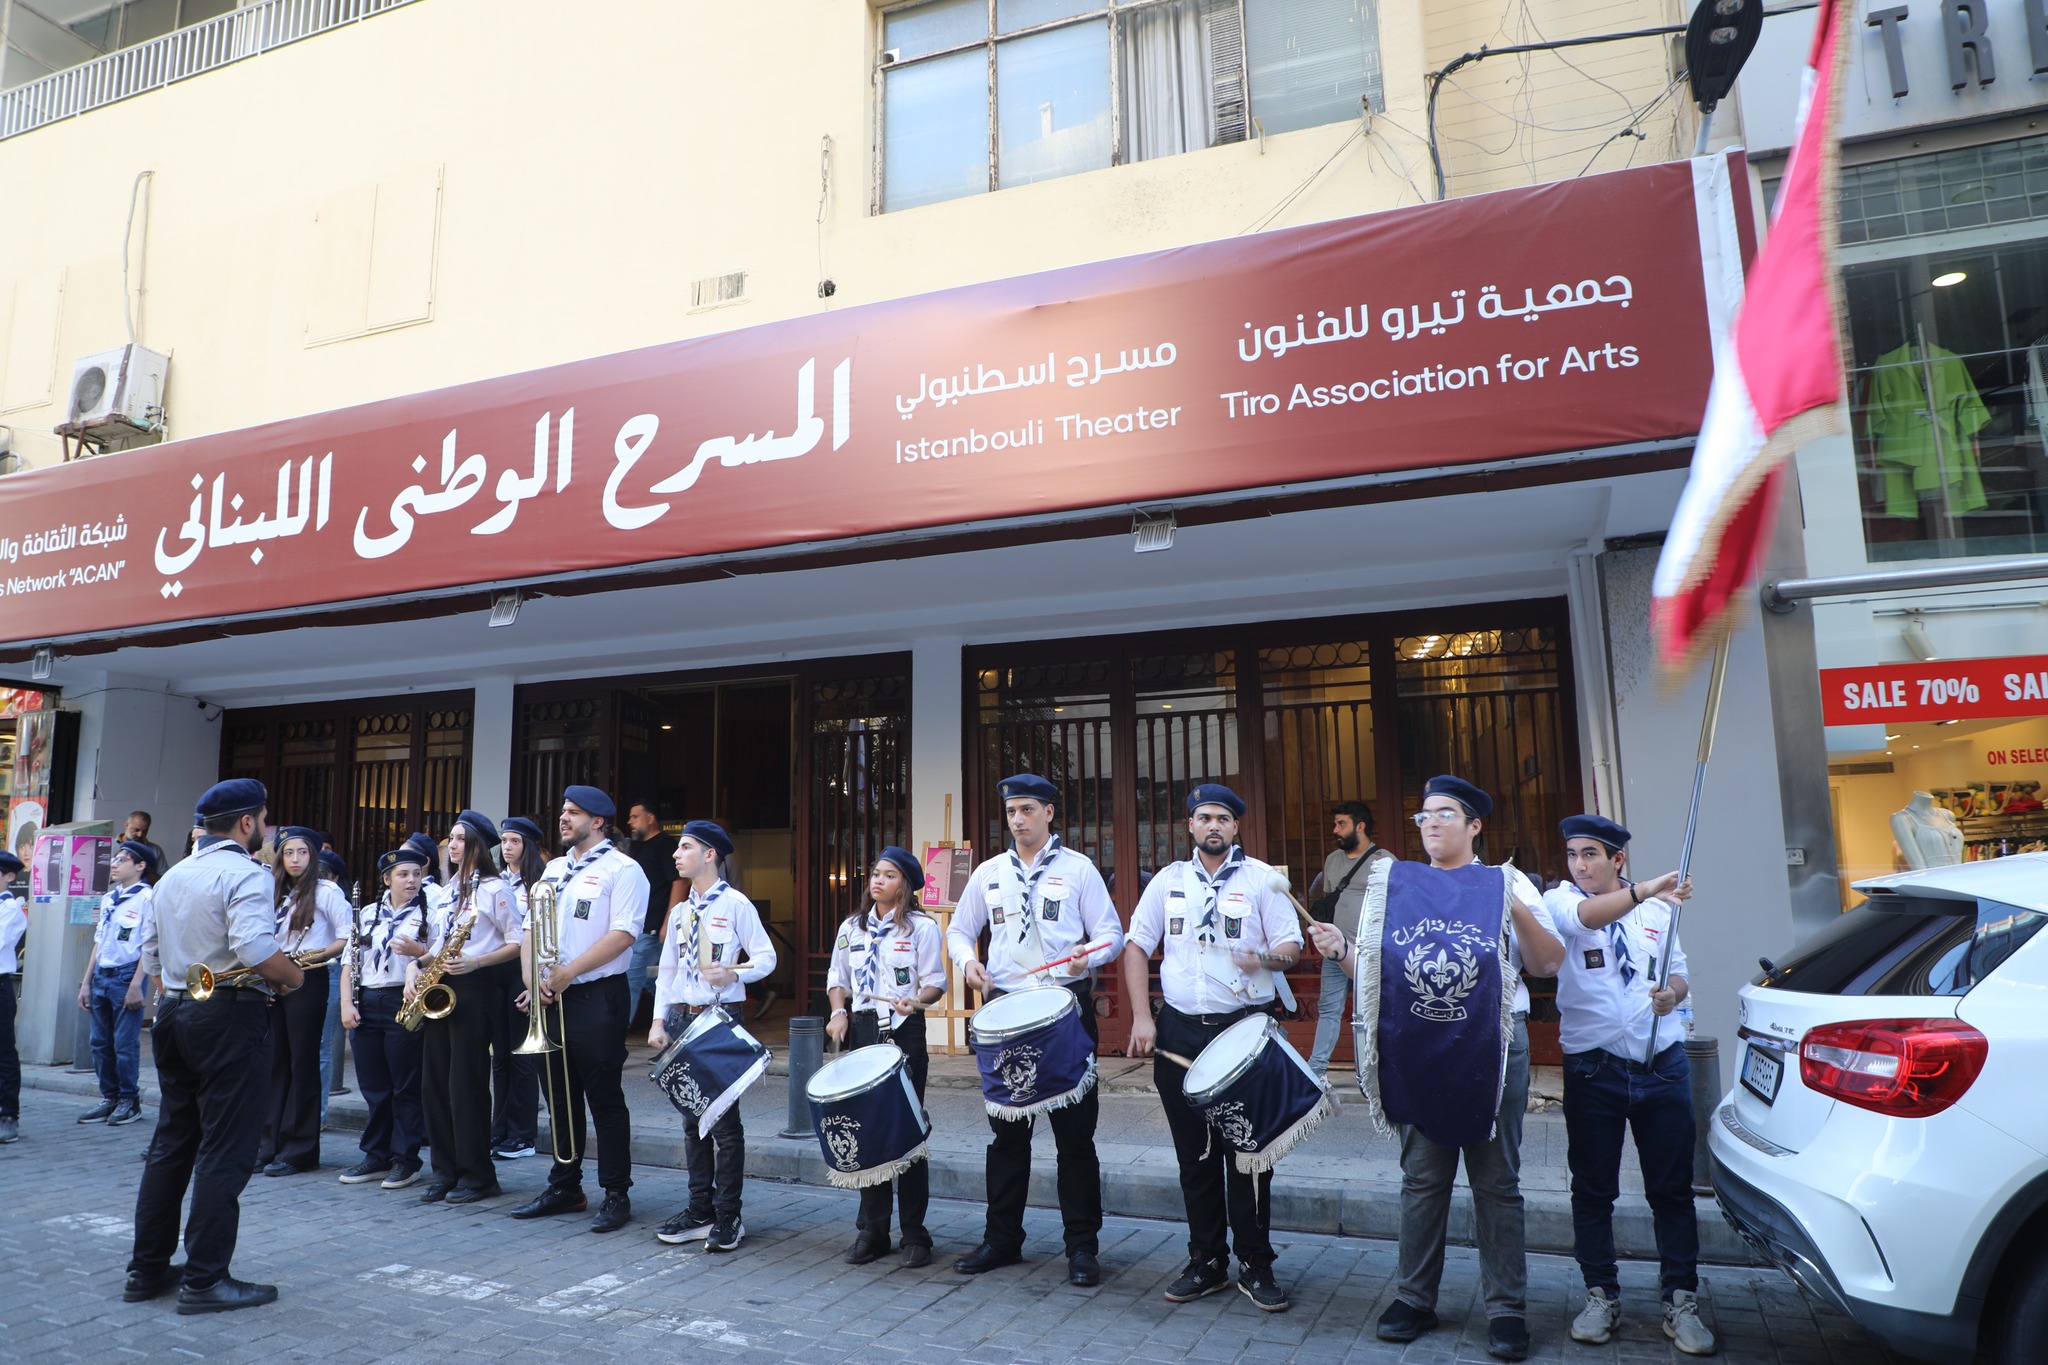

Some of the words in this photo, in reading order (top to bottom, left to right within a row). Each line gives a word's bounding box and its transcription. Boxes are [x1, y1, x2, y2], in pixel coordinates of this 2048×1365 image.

[1381, 289, 1466, 341] تيرو
[1478, 275, 1633, 321] جمعية
[1238, 304, 1369, 362] للفنون
[895, 352, 1055, 421] اسطنبولي
[1066, 342, 1177, 388] مسرح
[1219, 390, 1280, 419] Tiro
[1286, 363, 1489, 411] Association
[1496, 353, 1550, 383] for
[1559, 343, 1640, 376] Arts
[602, 357, 851, 530] المسرح
[895, 419, 1043, 464] Istanbouli
[1055, 406, 1182, 441] Theater
[22, 523, 77, 556] الثقافة
[80, 513, 128, 548] شبكة
[154, 451, 333, 600] اللبناني
[6, 569, 67, 596] Network
[1843, 680, 1907, 710] SALE
[1916, 677, 1980, 705] 70%
[1987, 750, 2007, 765] ON
